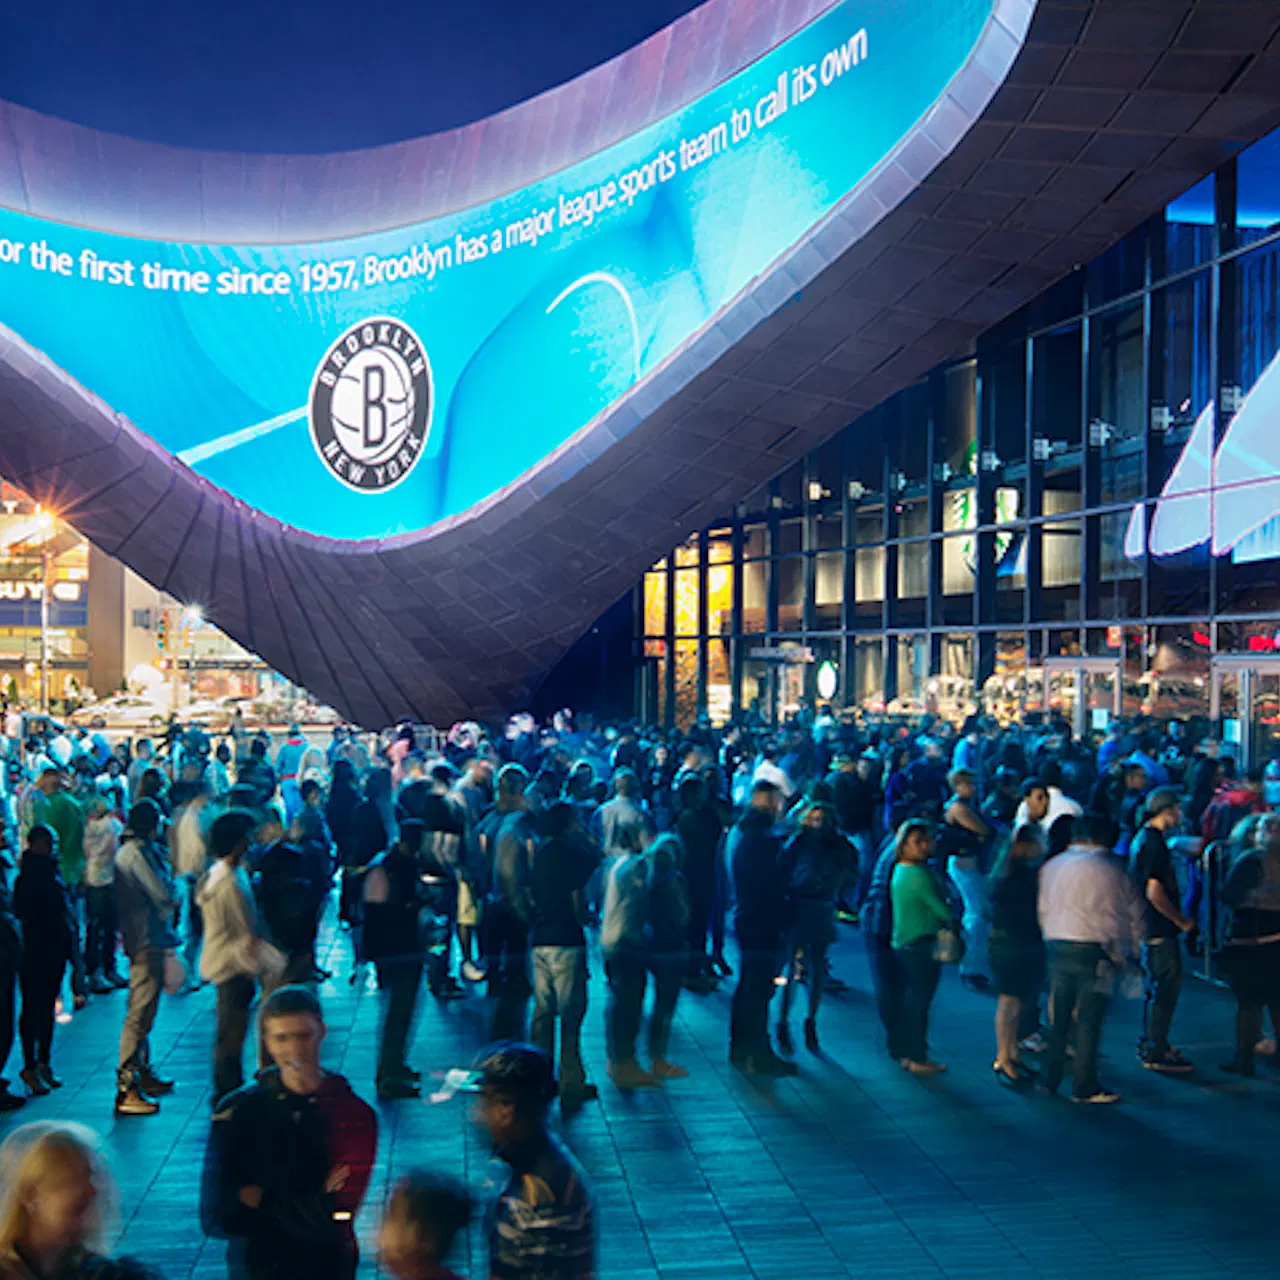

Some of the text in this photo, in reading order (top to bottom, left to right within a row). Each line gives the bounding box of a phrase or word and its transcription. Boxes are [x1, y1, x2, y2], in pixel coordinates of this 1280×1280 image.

[29, 240, 73, 276] the
[79, 249, 135, 287] first
[141, 263, 211, 293] time
[216, 267, 291, 294] since
[299, 260, 359, 293] 1957,
[363, 242, 452, 286] Brooklyn
[455, 231, 489, 265] has
[490, 232, 503, 255] a
[505, 208, 556, 249] major
[558, 181, 617, 228] league
[619, 148, 676, 206] sports
[679, 122, 727, 171] team
[730, 108, 751, 143] to
[755, 71, 788, 128] call
[791, 63, 817, 106] its
[820, 28, 868, 87] own
[319, 324, 424, 388] BROOKLYN
[363, 365, 387, 448] B
[323, 434, 420, 485] NEW YORK
